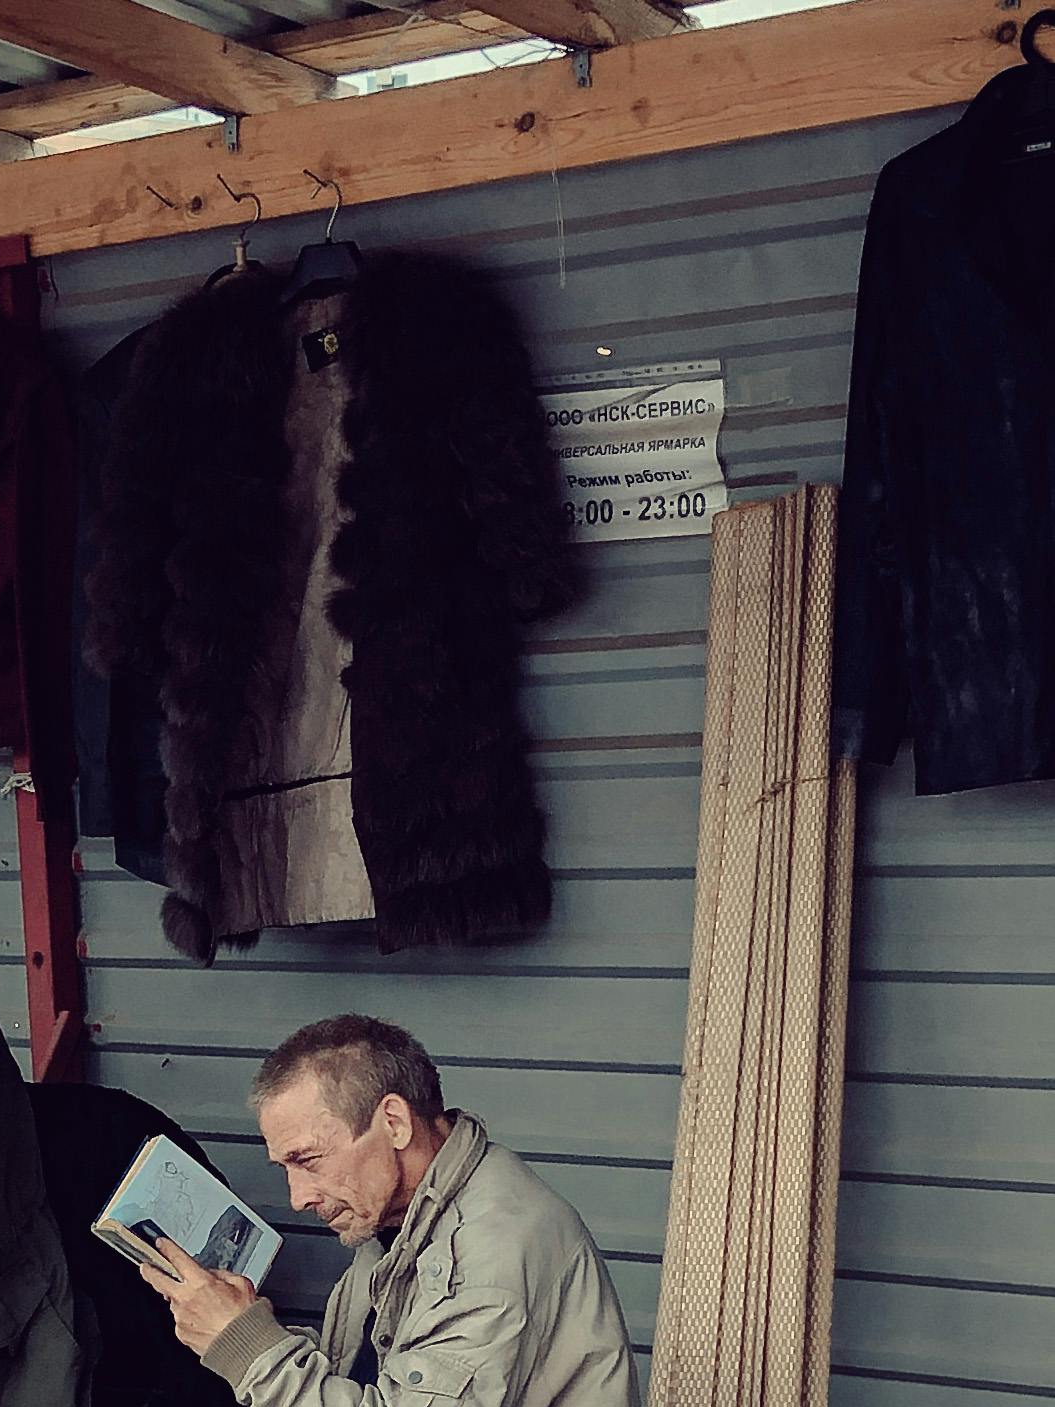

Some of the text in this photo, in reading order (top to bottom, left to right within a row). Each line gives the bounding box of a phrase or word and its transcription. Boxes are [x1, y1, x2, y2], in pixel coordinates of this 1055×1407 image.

[588, 398, 716, 423] «НСК-СЕРВИС»
[647, 437, 706, 452] ЯРМАРКА
[567, 469, 692, 488] Режим работы:
[638, 492, 706, 521] 23:00
